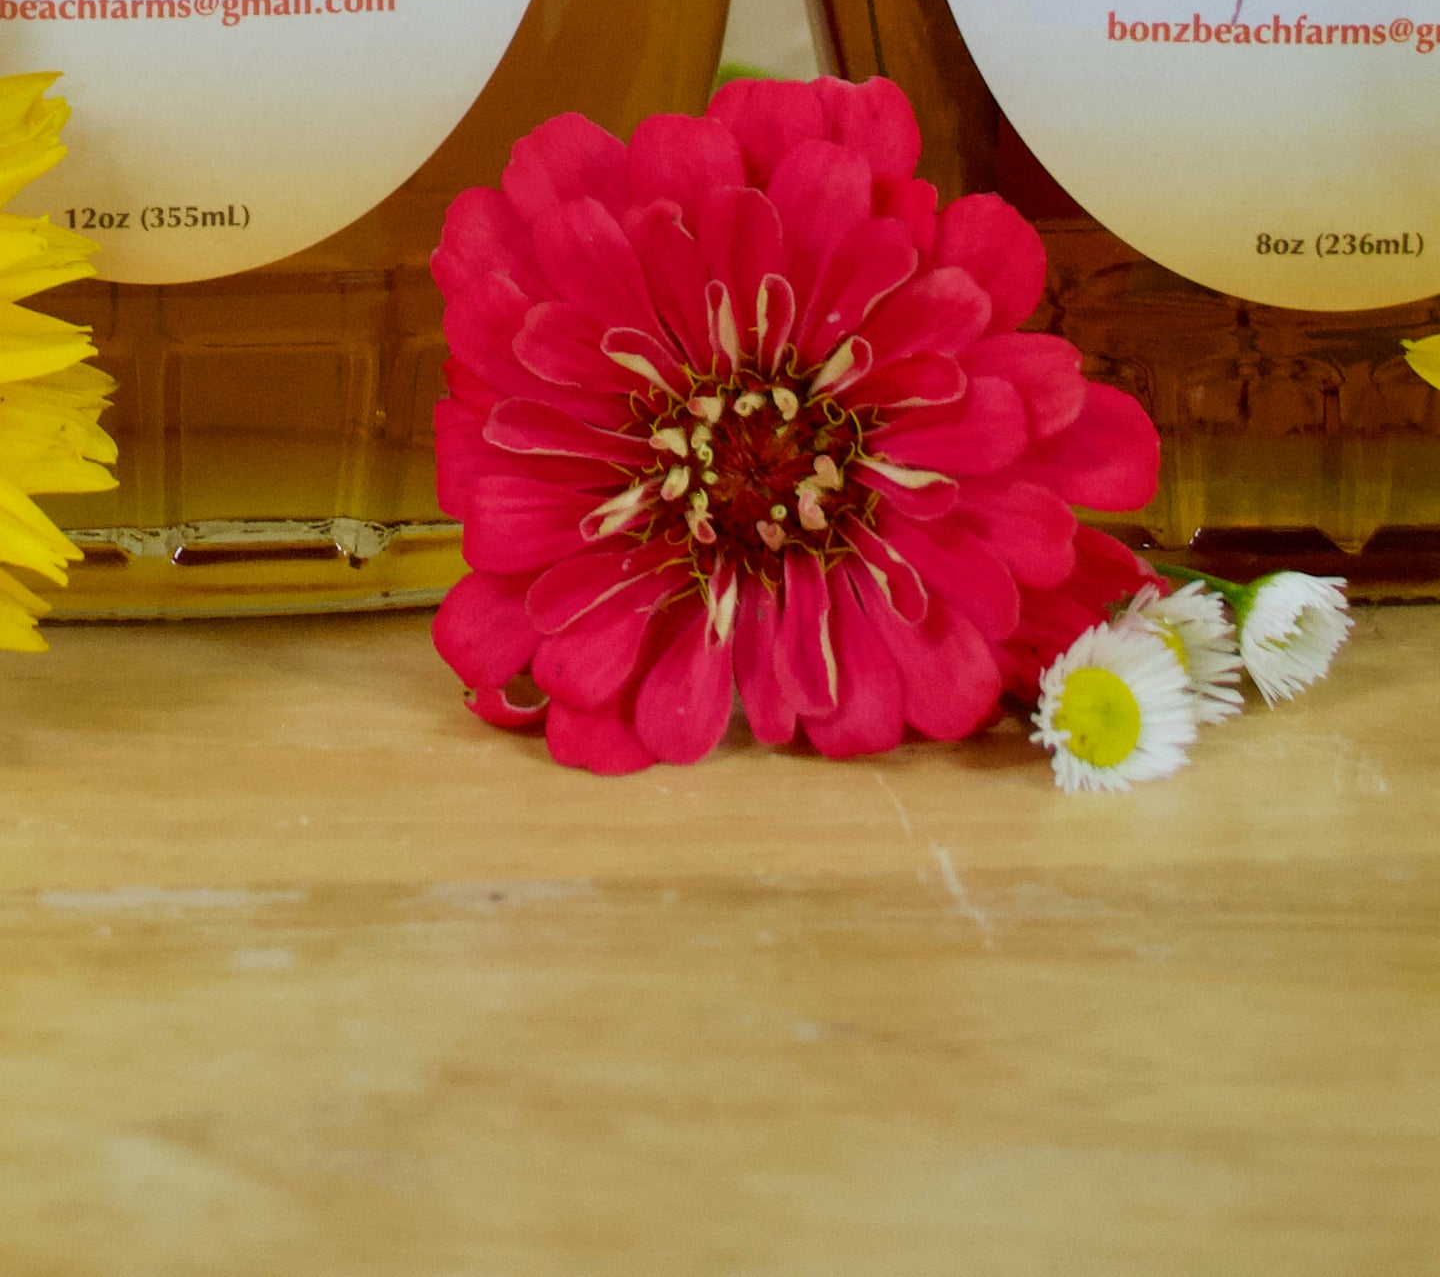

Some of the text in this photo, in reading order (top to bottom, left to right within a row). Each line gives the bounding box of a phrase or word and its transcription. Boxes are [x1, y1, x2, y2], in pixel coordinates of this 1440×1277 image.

[64, 204, 251, 231] 12oz (355mL)
[1255, 231, 1424, 258] 8oz (236mL)
